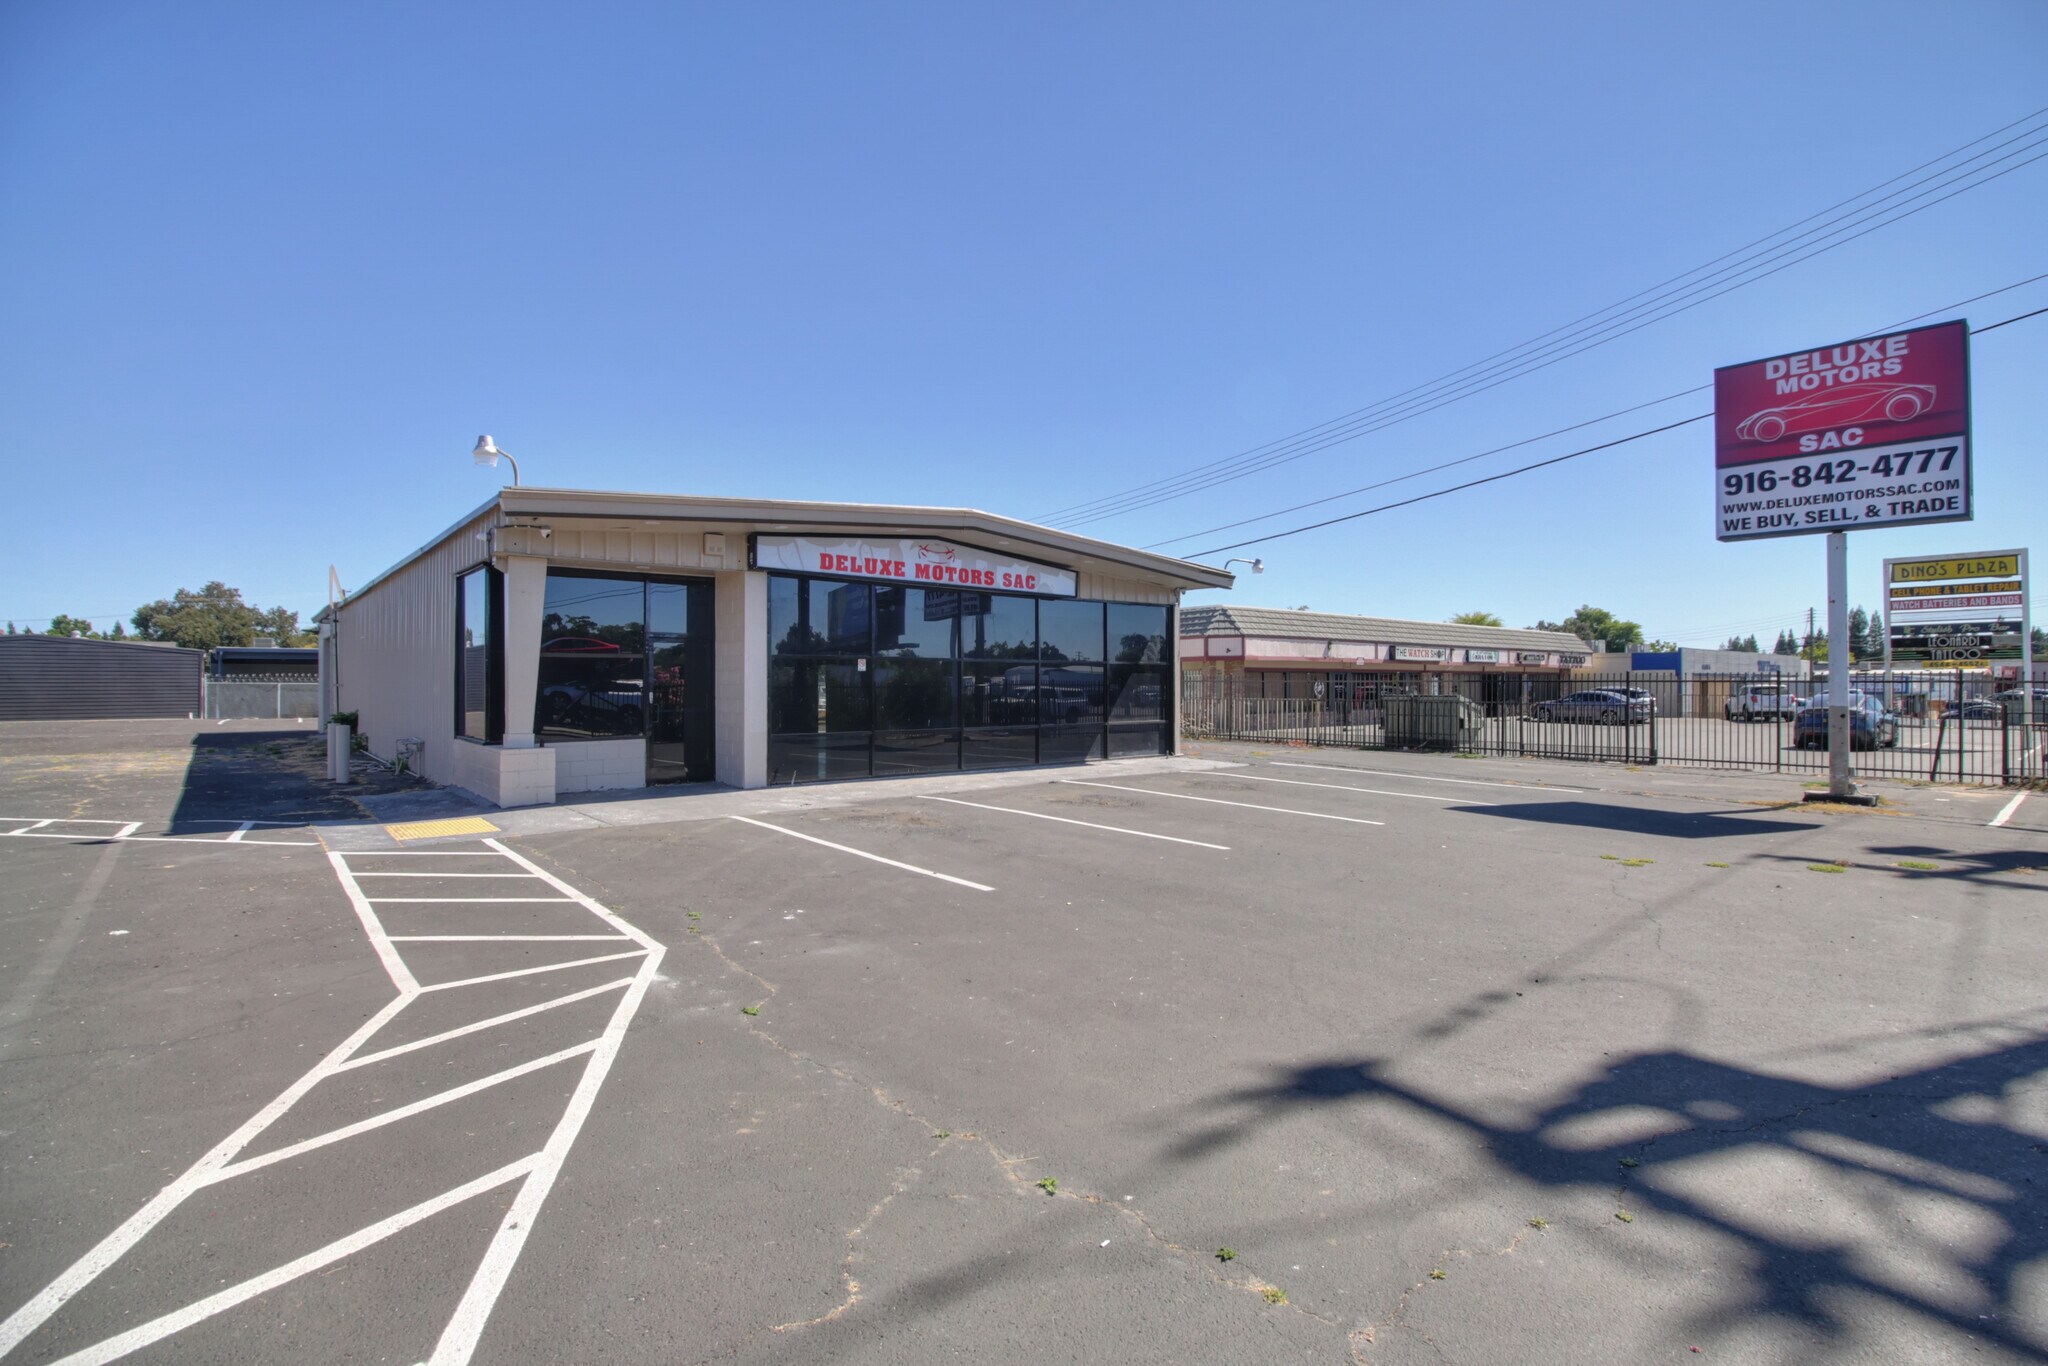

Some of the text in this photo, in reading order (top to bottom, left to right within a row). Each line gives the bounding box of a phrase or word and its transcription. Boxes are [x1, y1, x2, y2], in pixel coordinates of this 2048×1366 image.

[1765, 334, 1910, 380] DELUXE
[1776, 358, 1903, 395] MOTORS
[1799, 427, 1864, 452] SAC
[1723, 445, 1960, 496] 916-842-4777
[1722, 478, 1960, 514] WWW.DELUXEMOTORSSAC.COM
[1723, 496, 1959, 532] WE BUY, SELL, & TRADE
[819, 552, 1036, 590] DELUXE MOTORS SAC
[1901, 560, 2008, 578] DINO'S PLAZA
[1892, 582, 2020, 597] CELL PHONE & TABLET REPAIR
[1892, 595, 2020, 610] WATCH BATTERIES AND BANDS
[1396, 648, 1407, 657] THE
[1408, 648, 1430, 658] WATCH
[1931, 649, 1981, 660] TATTOO
